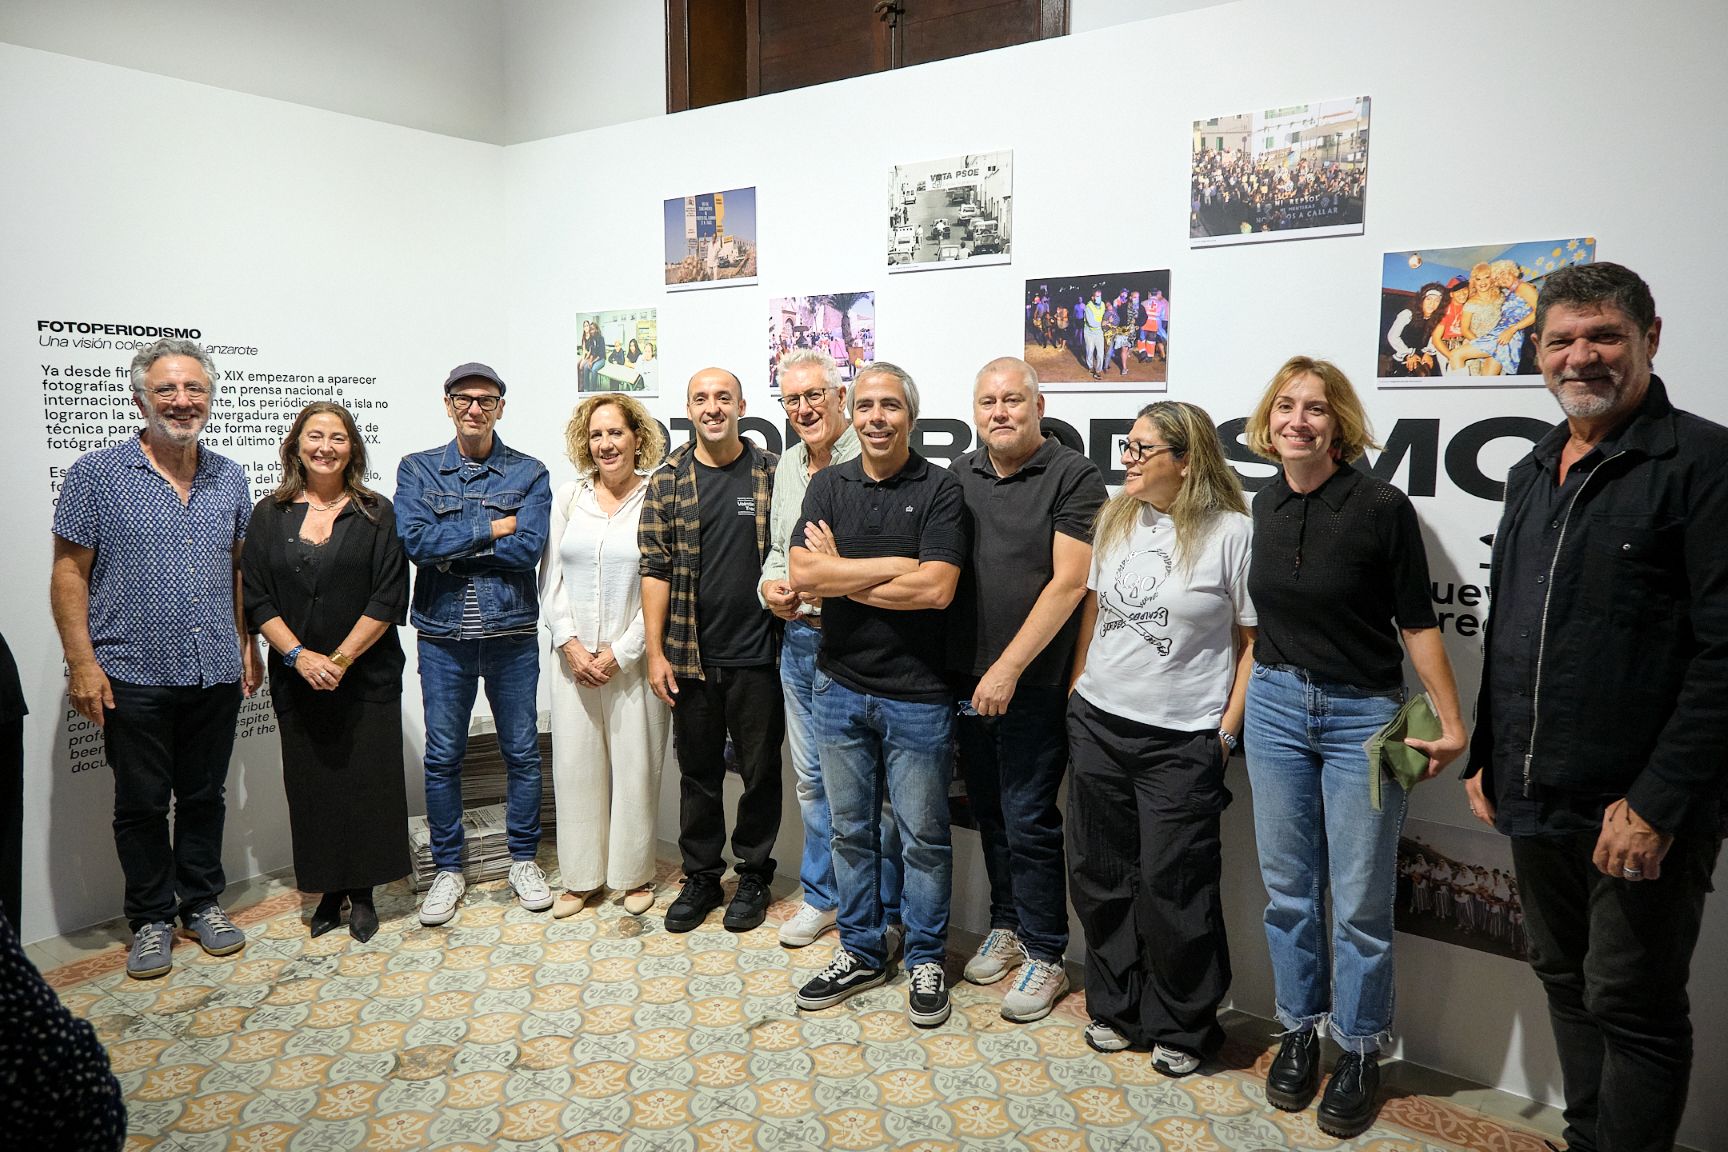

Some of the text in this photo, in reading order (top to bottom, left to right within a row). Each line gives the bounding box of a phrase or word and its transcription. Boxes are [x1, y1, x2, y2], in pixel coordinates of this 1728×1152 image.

[955, 168, 980, 179] PSOE
[1306, 206, 1338, 217] CALLAR
[37, 320, 202, 339] FOTOPERIODISMO
[38, 335, 69, 348] Una
[72, 336, 112, 350] visión
[41, 364, 60, 376] Ya
[64, 365, 111, 378] desde
[224, 370, 244, 381] XIX
[248, 372, 315, 385] empezaron
[317, 375, 325, 384] a
[327, 375, 377, 386] aparecer
[42, 379, 123, 394] fotografías
[220, 385, 237, 394] en
[240, 385, 282, 397] prensa
[285, 385, 334, 396] nacional
[336, 388, 344, 396] e
[211, 397, 235, 409] nte,
[238, 398, 256, 407] los
[342, 399, 352, 408] la
[354, 399, 373, 409] isla
[375, 401, 389, 409] no
[45, 409, 108, 423] lograron
[112, 410, 125, 420] la
[45, 423, 104, 435] técnica
[108, 424, 141, 437] para
[204, 423, 221, 434] de
[225, 423, 262, 434] forma
[365, 422, 379, 433] de
[46, 437, 123, 451] fotógrafos
[199, 436, 219, 447] sta
[222, 436, 233, 446] el
[236, 435, 275, 446] último
[364, 434, 381, 444] XX.
[253, 460, 264, 471] la
[255, 473, 274, 484] del
[363, 469, 382, 482] glo,
[241, 726, 255, 739] of
[256, 723, 276, 735] the
